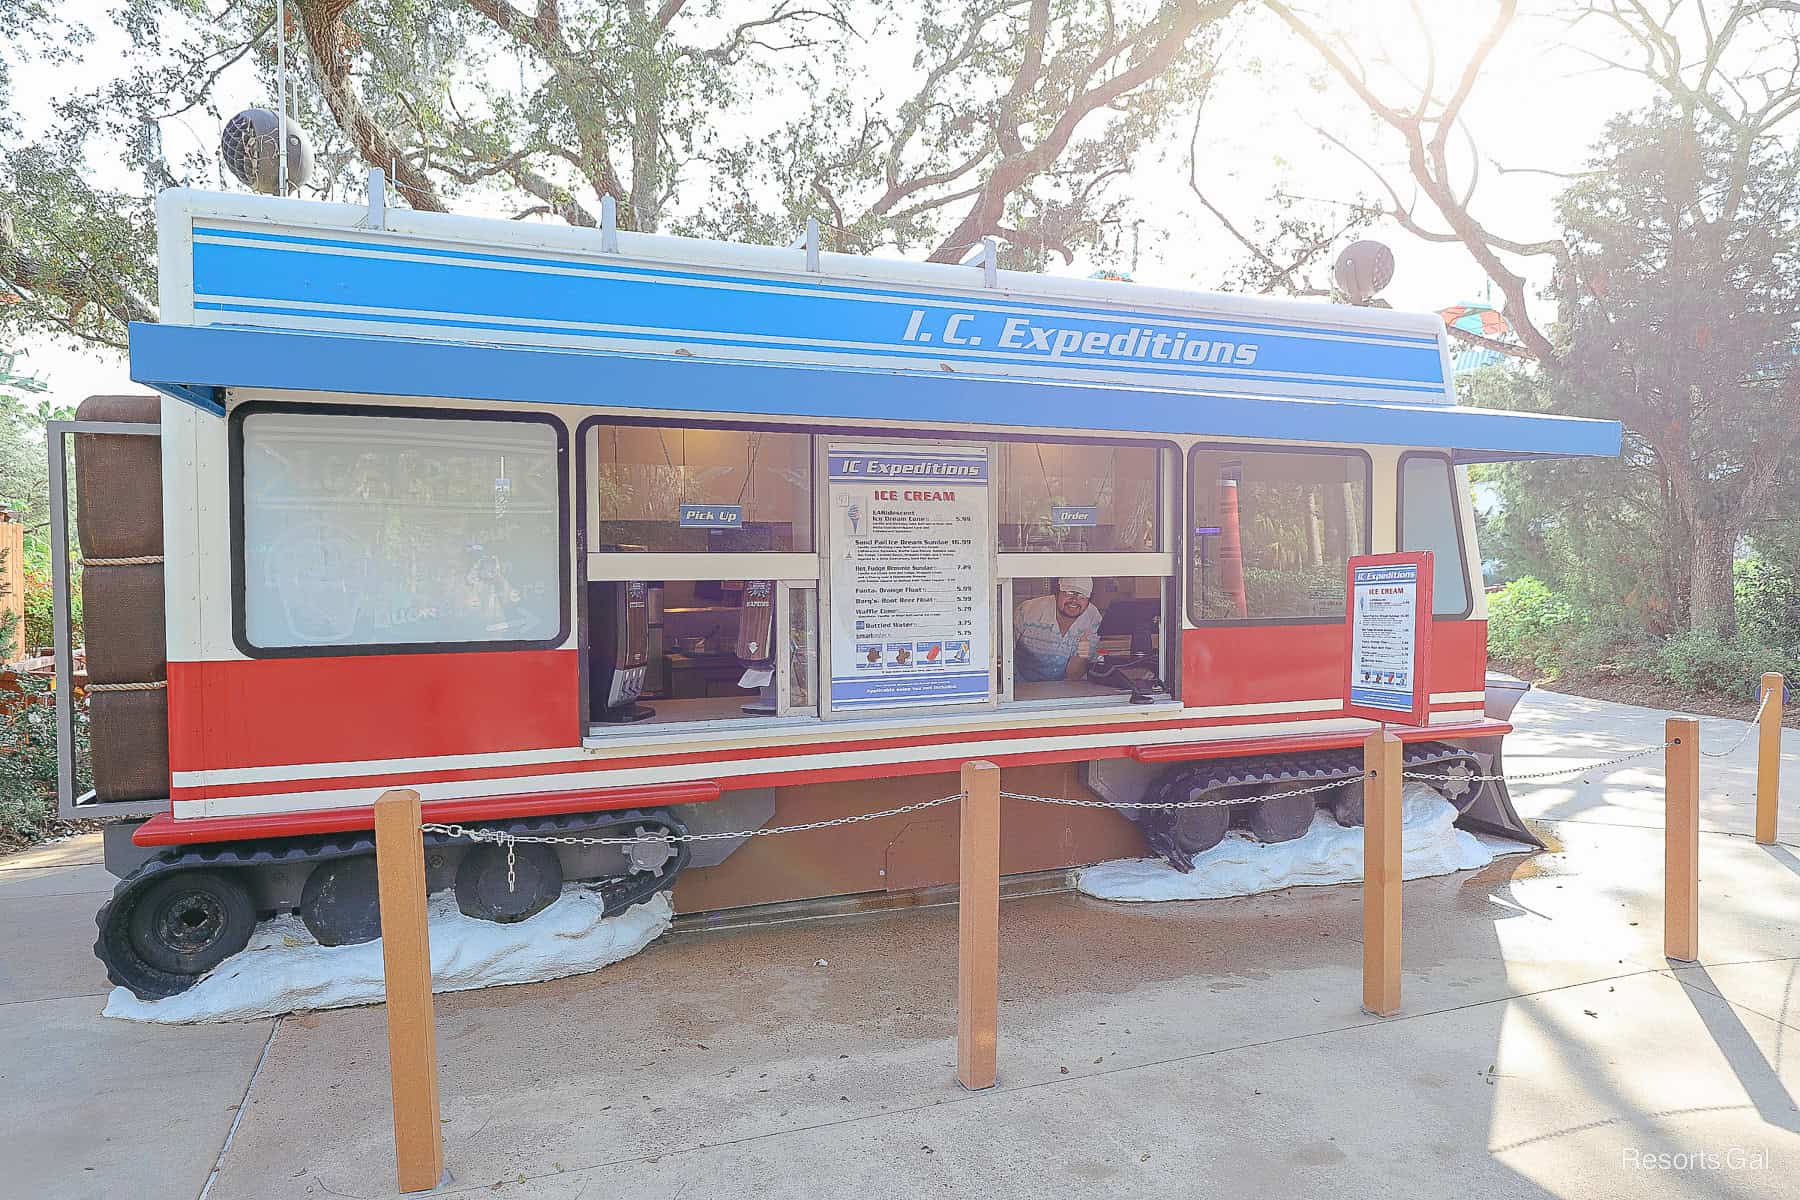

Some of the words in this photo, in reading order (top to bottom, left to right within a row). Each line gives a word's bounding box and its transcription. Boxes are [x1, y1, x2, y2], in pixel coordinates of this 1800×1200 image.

[902, 309, 932, 343] I.
[942, 313, 983, 346] C.
[997, 317, 1259, 366] Expeditions
[842, 460, 861, 473] IC
[866, 460, 980, 476] Expeditions
[874, 490, 897, 501] ICE
[904, 490, 956, 502] CREAM
[686, 510, 714, 521] Pick
[720, 511, 737, 522] Up
[1061, 511, 1088, 520] Order
[1367, 570, 1416, 581] Expeditions
